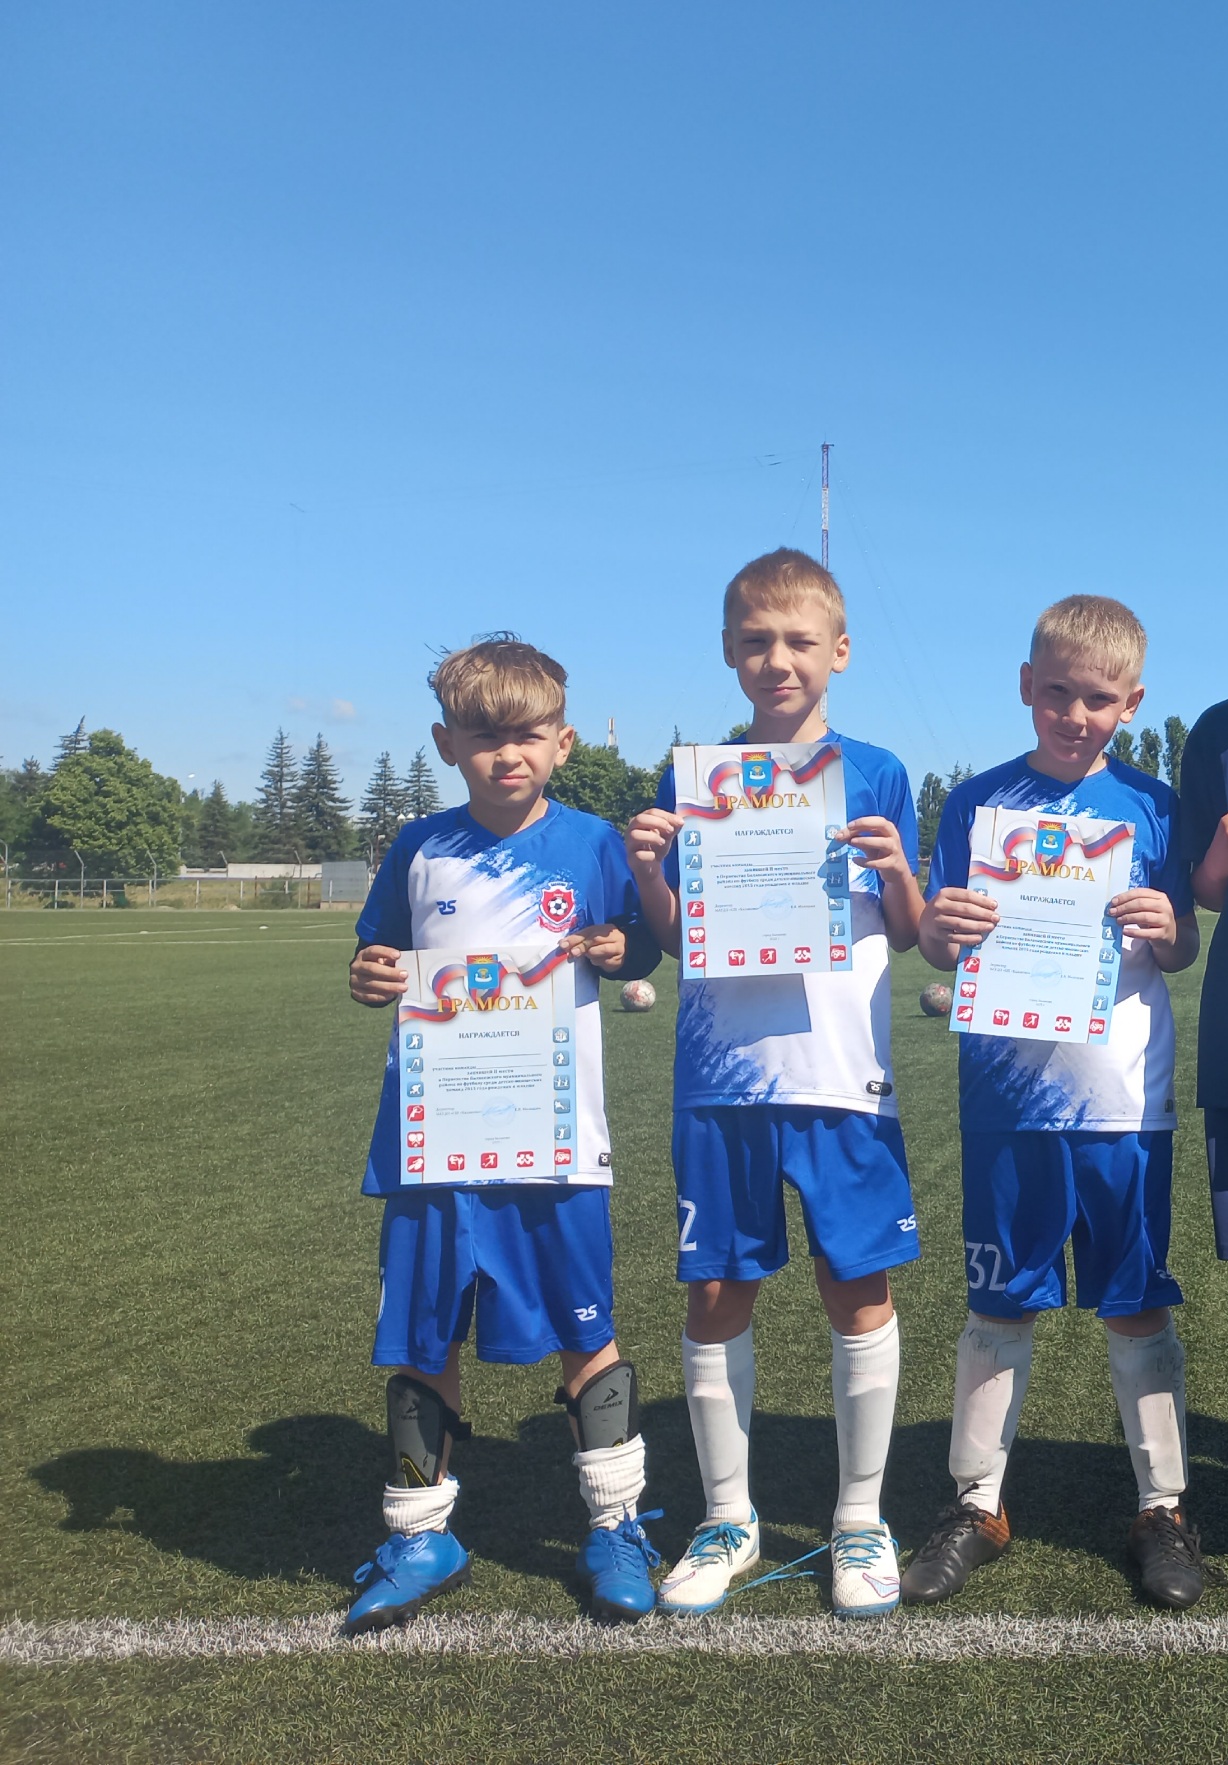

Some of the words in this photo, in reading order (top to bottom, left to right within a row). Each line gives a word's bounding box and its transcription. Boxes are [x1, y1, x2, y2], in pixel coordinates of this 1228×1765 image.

[713, 792, 811, 810] ГРАМОТА
[734, 828, 794, 836] НАГРАЖДАЕТСЯ
[1004, 857, 1096, 882] ГРАМОТА
[1019, 894, 1076, 906] НАГРАЖДАЕТСЯ
[436, 995, 539, 1013] ГРАМОТА
[458, 1030, 520, 1039] НАГРАЖДАЕТСЯ
[966, 1241, 1008, 1292] 32
[593, 1399, 623, 1411] DEMIX
